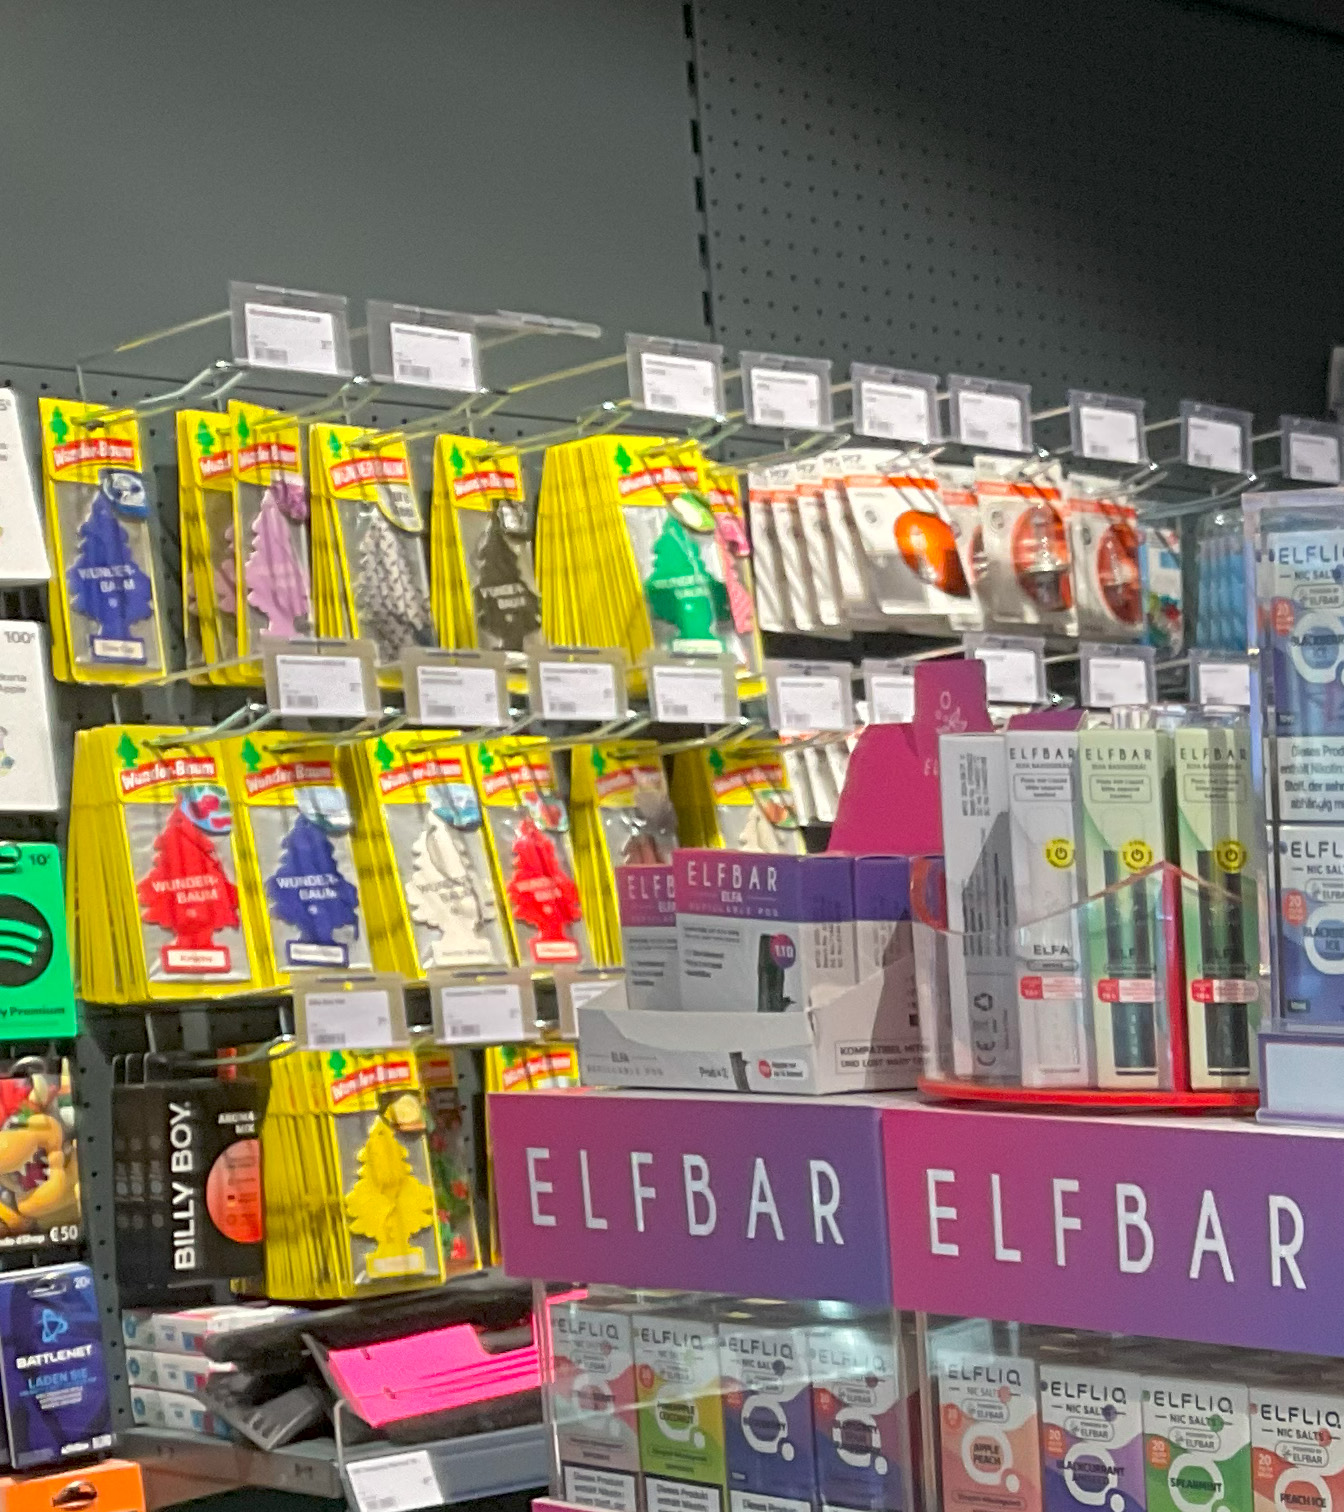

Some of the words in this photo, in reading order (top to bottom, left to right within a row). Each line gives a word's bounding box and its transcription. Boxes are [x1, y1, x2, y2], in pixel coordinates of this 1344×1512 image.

[1009, 747, 1075, 761] ELFBAR
[1085, 747, 1152, 761] ELFBAR
[152, 874, 220, 892] WUNDER-
[687, 861, 778, 891] ELFBAR
[176, 886, 218, 904] BAUM
[1033, 945, 1069, 955] ELFA
[526, 1146, 844, 1246] ELFBAR
[171, 1183, 196, 1270] BILLY
[926, 1168, 1307, 1291] ELFBAR
